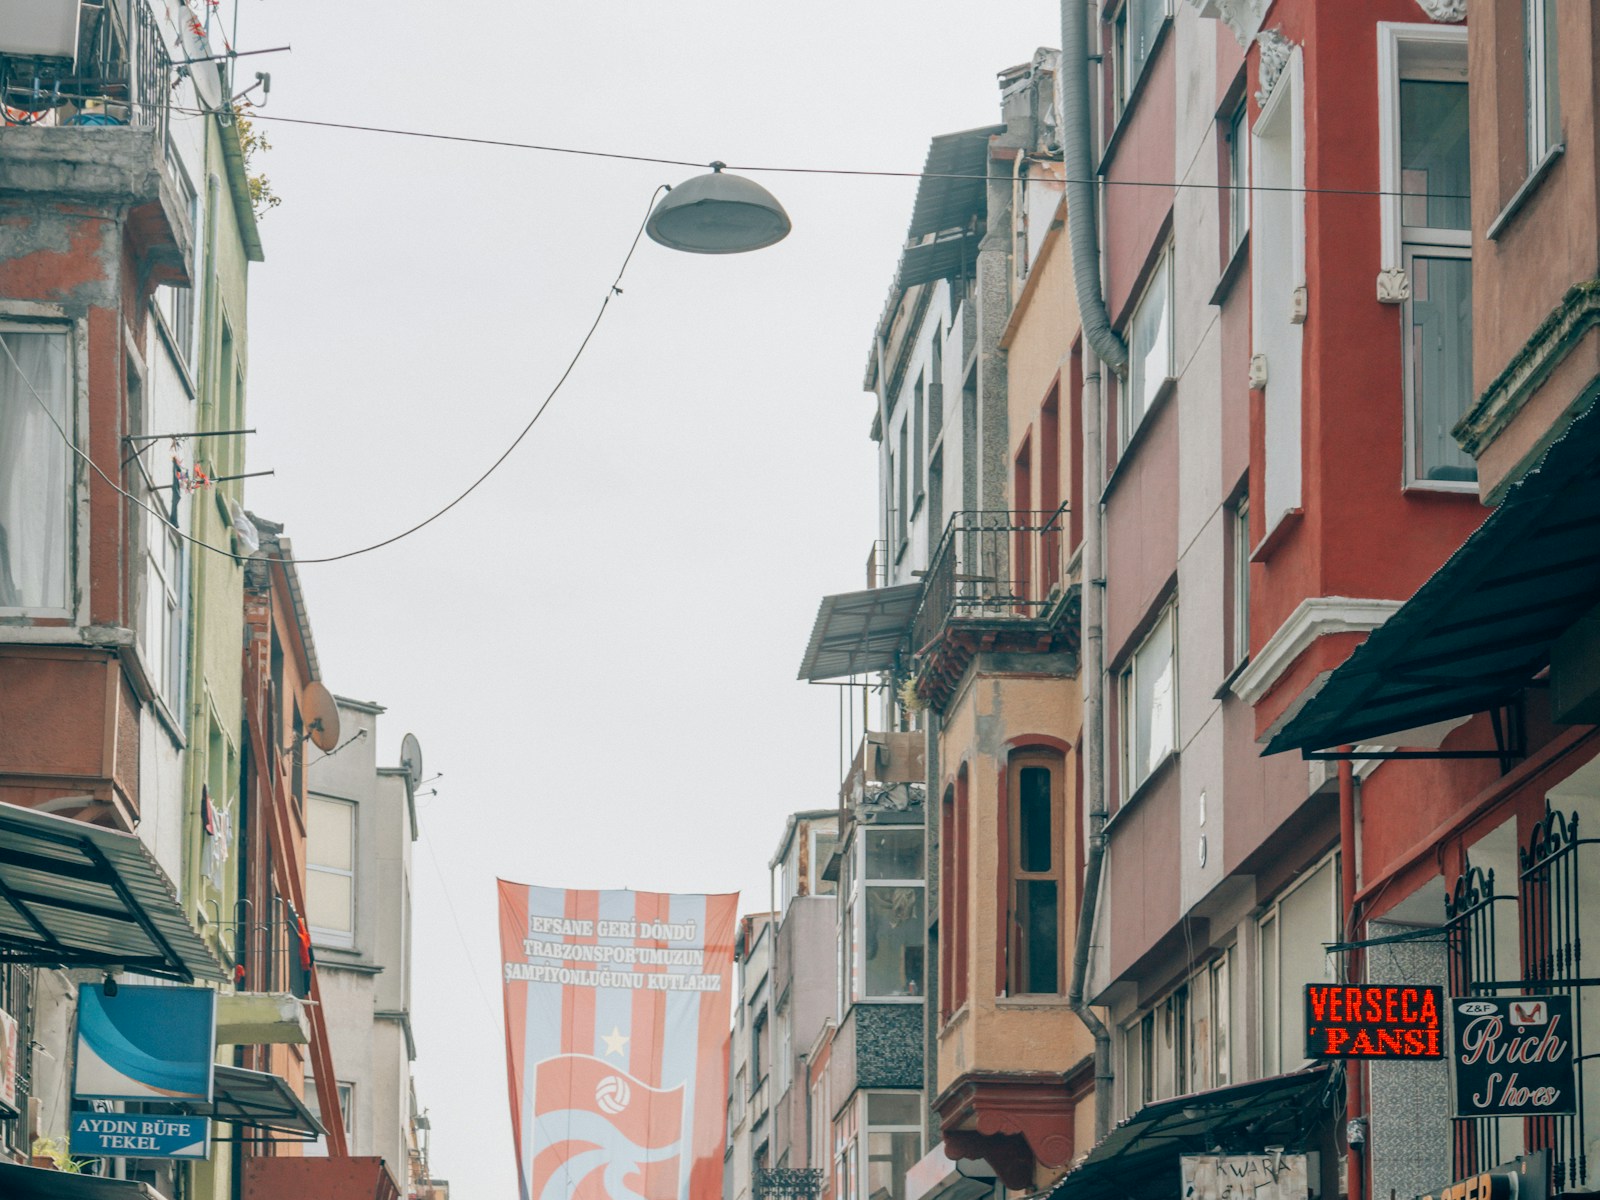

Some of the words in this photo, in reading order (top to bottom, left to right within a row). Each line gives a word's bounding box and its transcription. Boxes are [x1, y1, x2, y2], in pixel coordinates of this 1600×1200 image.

[531, 915, 593, 937] EFSANE
[597, 917, 636, 939] GERİ
[640, 919, 696, 941] DÖNDÜ
[523, 938, 705, 966] TRABZONSPOR'UMUZUN
[504, 961, 644, 989] ŞAMPİYONLUĞUNU
[647, 973, 721, 992] KUTLARIZ
[1466, 1004, 1491, 1013] Z&F
[1461, 1014, 1568, 1065] Rich
[1472, 1072, 1561, 1108] Shoes
[77, 1119, 137, 1134] AYDIN
[141, 1120, 191, 1137] BÜFE
[99, 1135, 161, 1150] TEKEL
